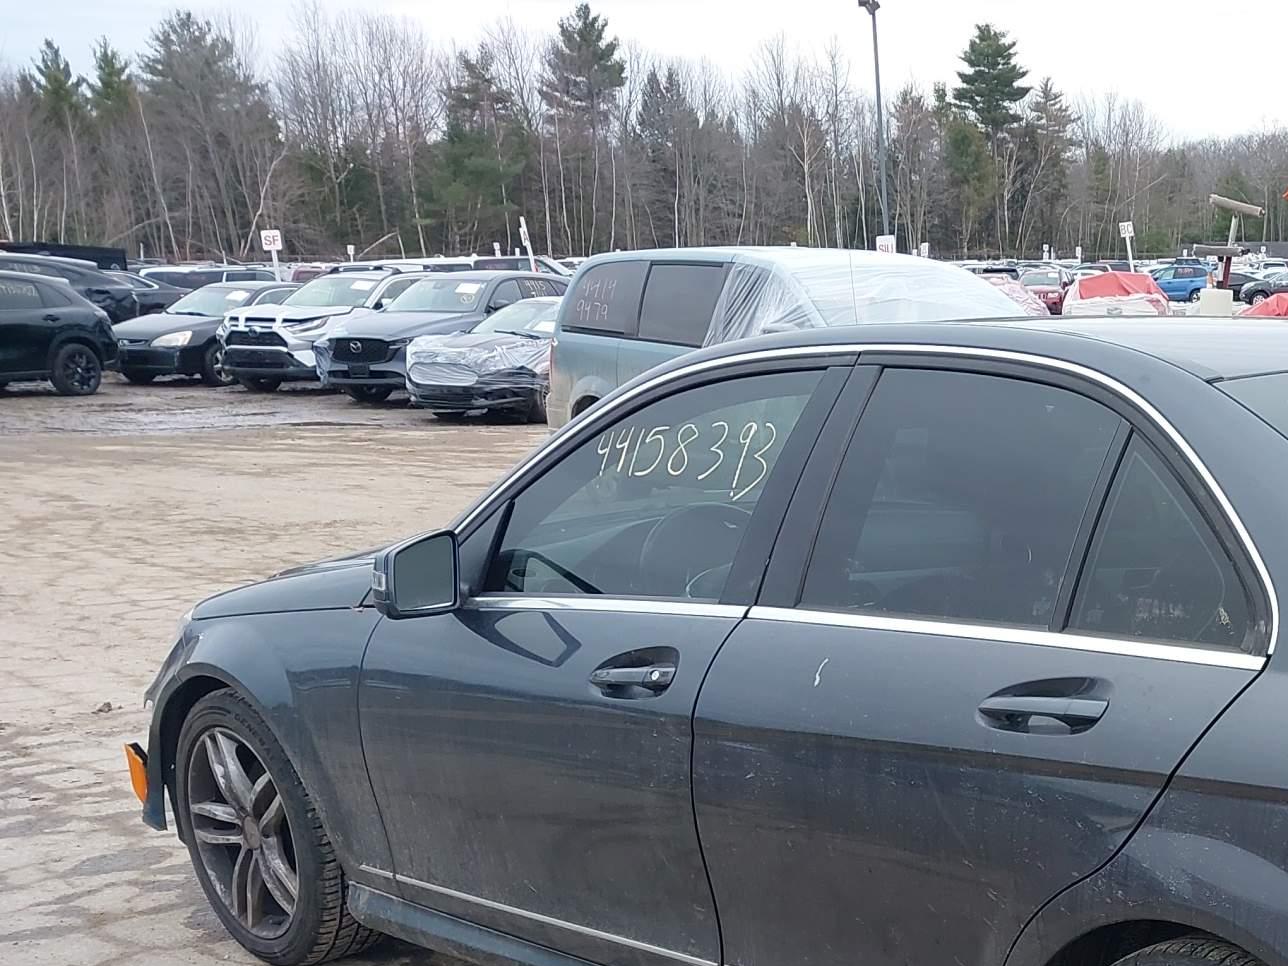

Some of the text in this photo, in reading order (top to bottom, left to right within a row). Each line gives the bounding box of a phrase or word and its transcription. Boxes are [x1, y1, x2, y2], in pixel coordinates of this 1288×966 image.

[1120, 223, 1133, 235] BC
[264, 235, 279, 246] SF
[597, 422, 776, 501] 44158393
